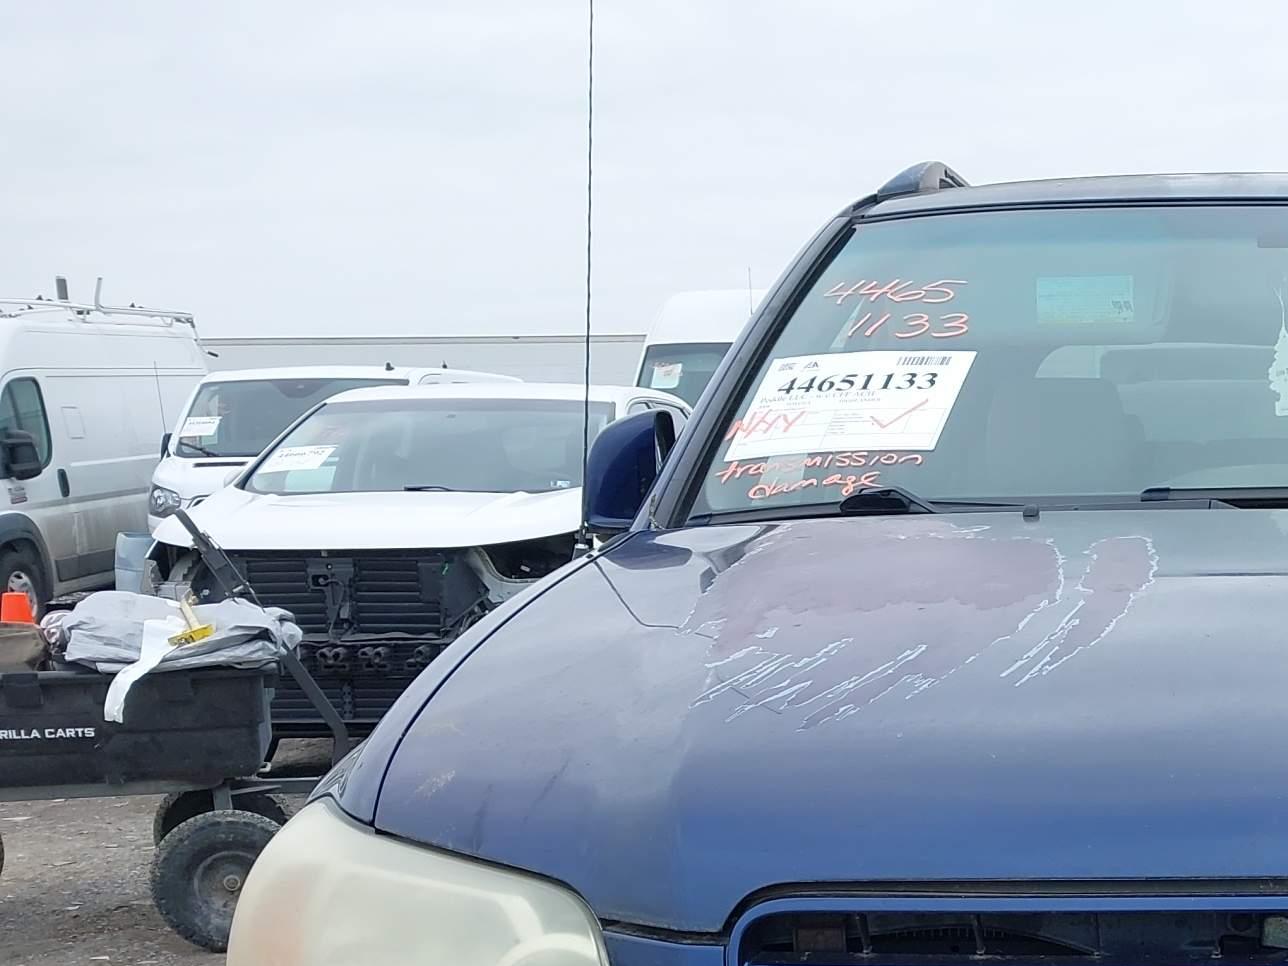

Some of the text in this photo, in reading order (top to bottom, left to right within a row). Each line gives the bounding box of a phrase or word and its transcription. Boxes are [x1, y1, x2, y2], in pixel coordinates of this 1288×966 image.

[823, 279, 969, 305] 4465
[847, 312, 969, 338] 1133
[777, 372, 938, 395] 44651133
[44, 727, 96, 739] CARTS
